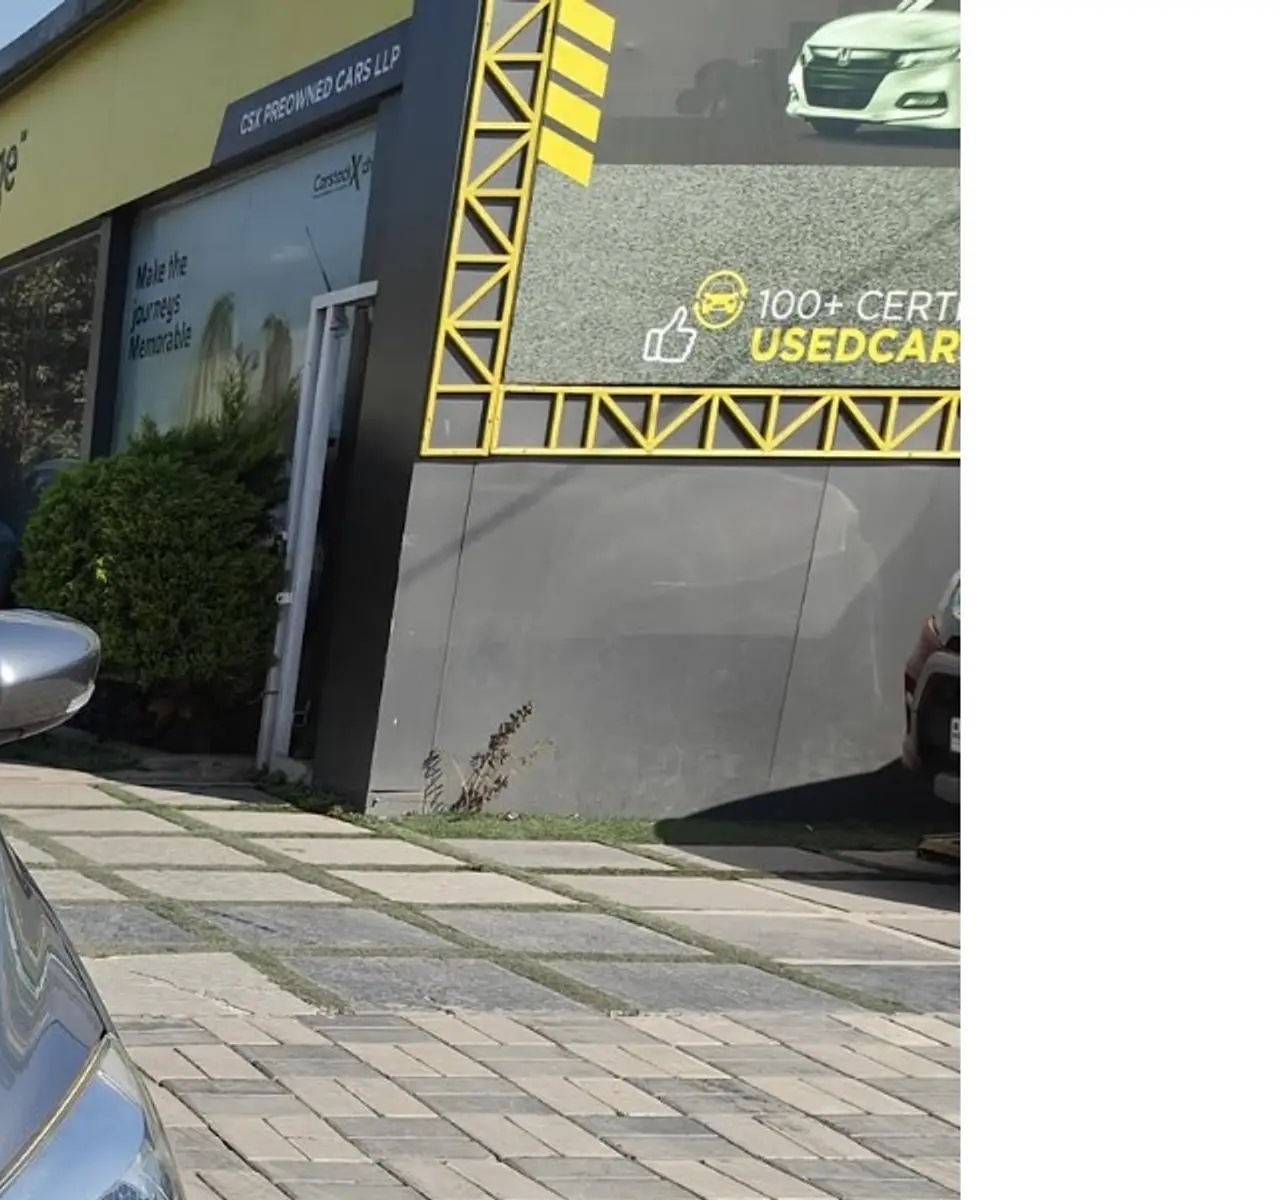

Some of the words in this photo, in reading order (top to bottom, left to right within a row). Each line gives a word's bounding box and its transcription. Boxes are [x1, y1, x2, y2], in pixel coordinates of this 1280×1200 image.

[240, 106, 263, 135] CSX
[263, 75, 333, 125] PREOWNED
[335, 58, 372, 93] CARS
[374, 45, 401, 78] LLP
[136, 259, 165, 289] Make
[168, 250, 188, 280] the
[759, 289, 843, 320] 100+
[129, 320, 192, 360] Memorable
